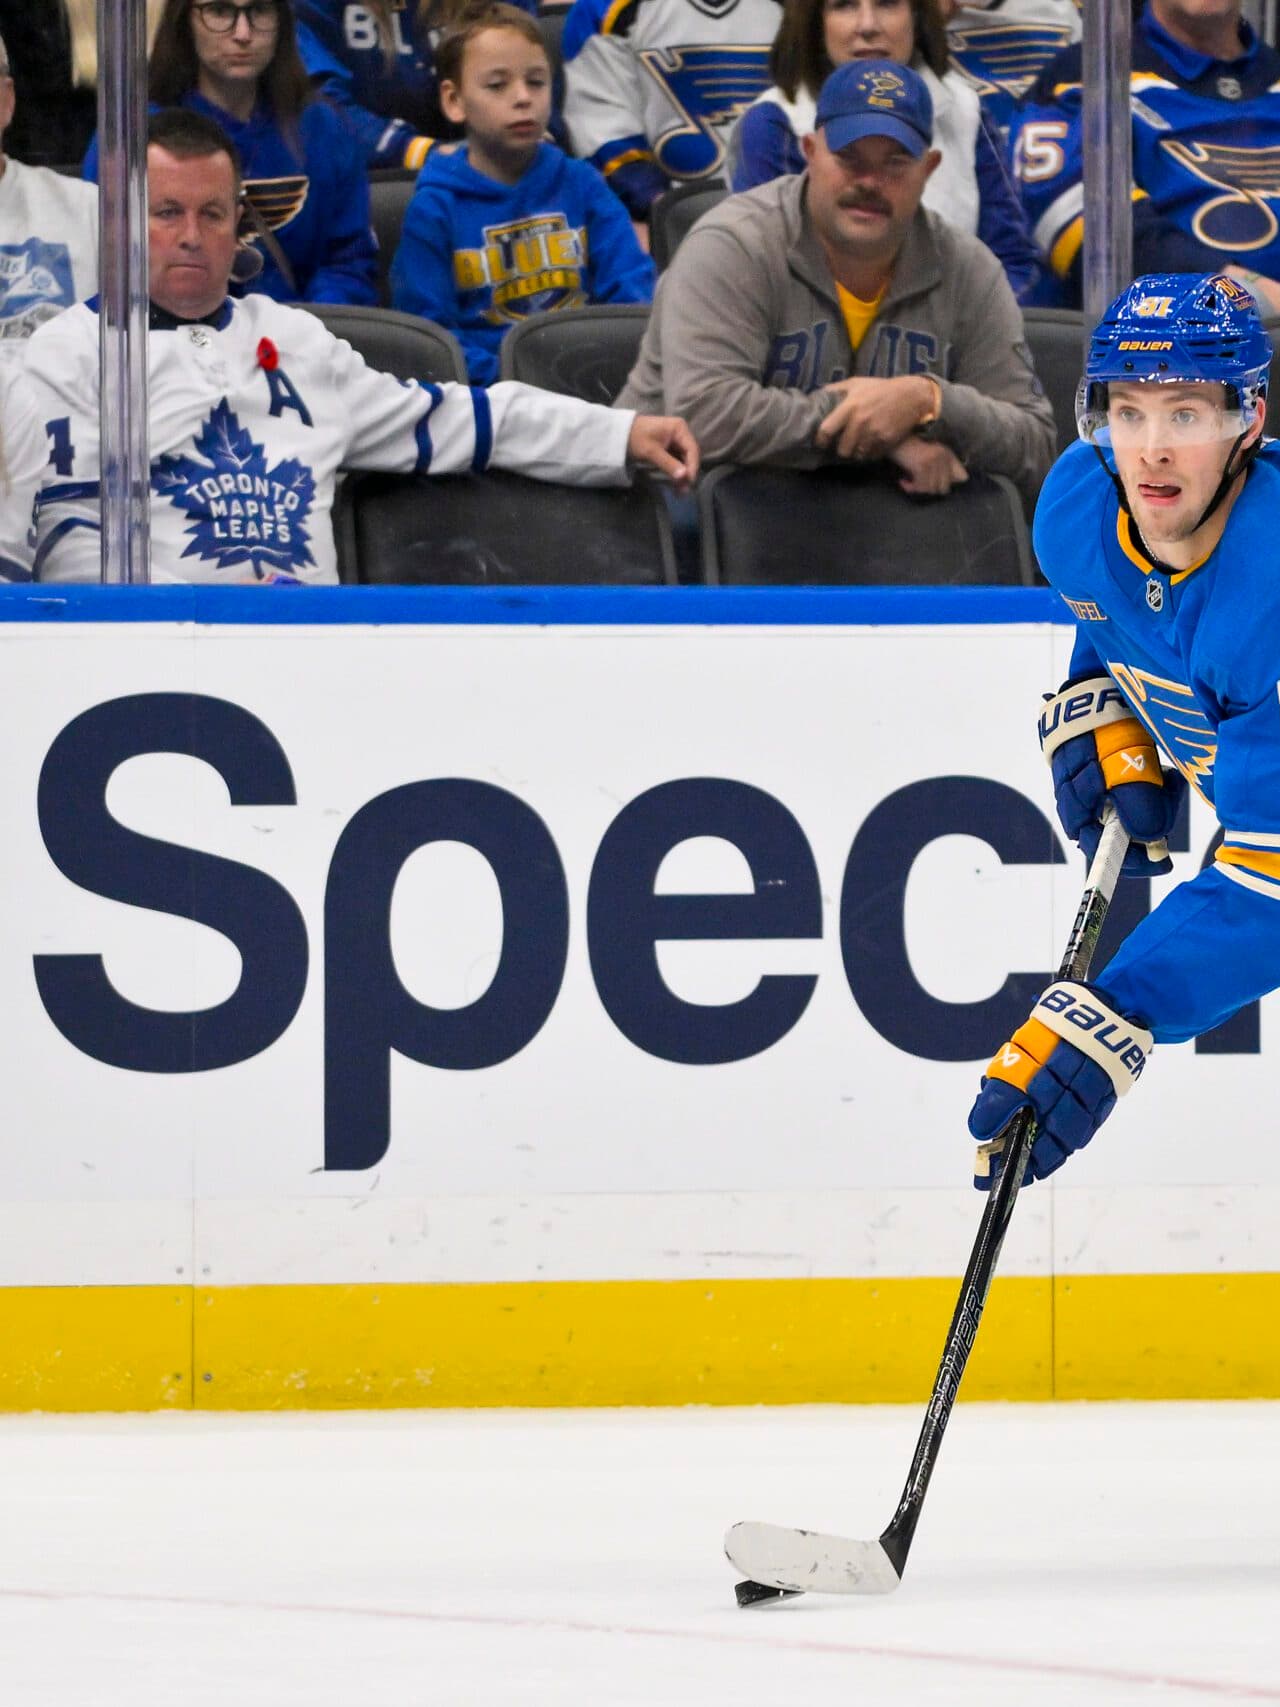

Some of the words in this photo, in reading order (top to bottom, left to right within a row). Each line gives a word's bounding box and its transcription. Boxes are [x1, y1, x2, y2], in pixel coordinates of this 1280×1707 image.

[453, 225, 588, 288] BLUE
[1118, 340, 1173, 351] BAUER
[267, 366, 314, 428] A
[185, 472, 300, 511] TORONTO
[209, 499, 291, 524] MAPLE
[212, 519, 292, 544] LEAFS
